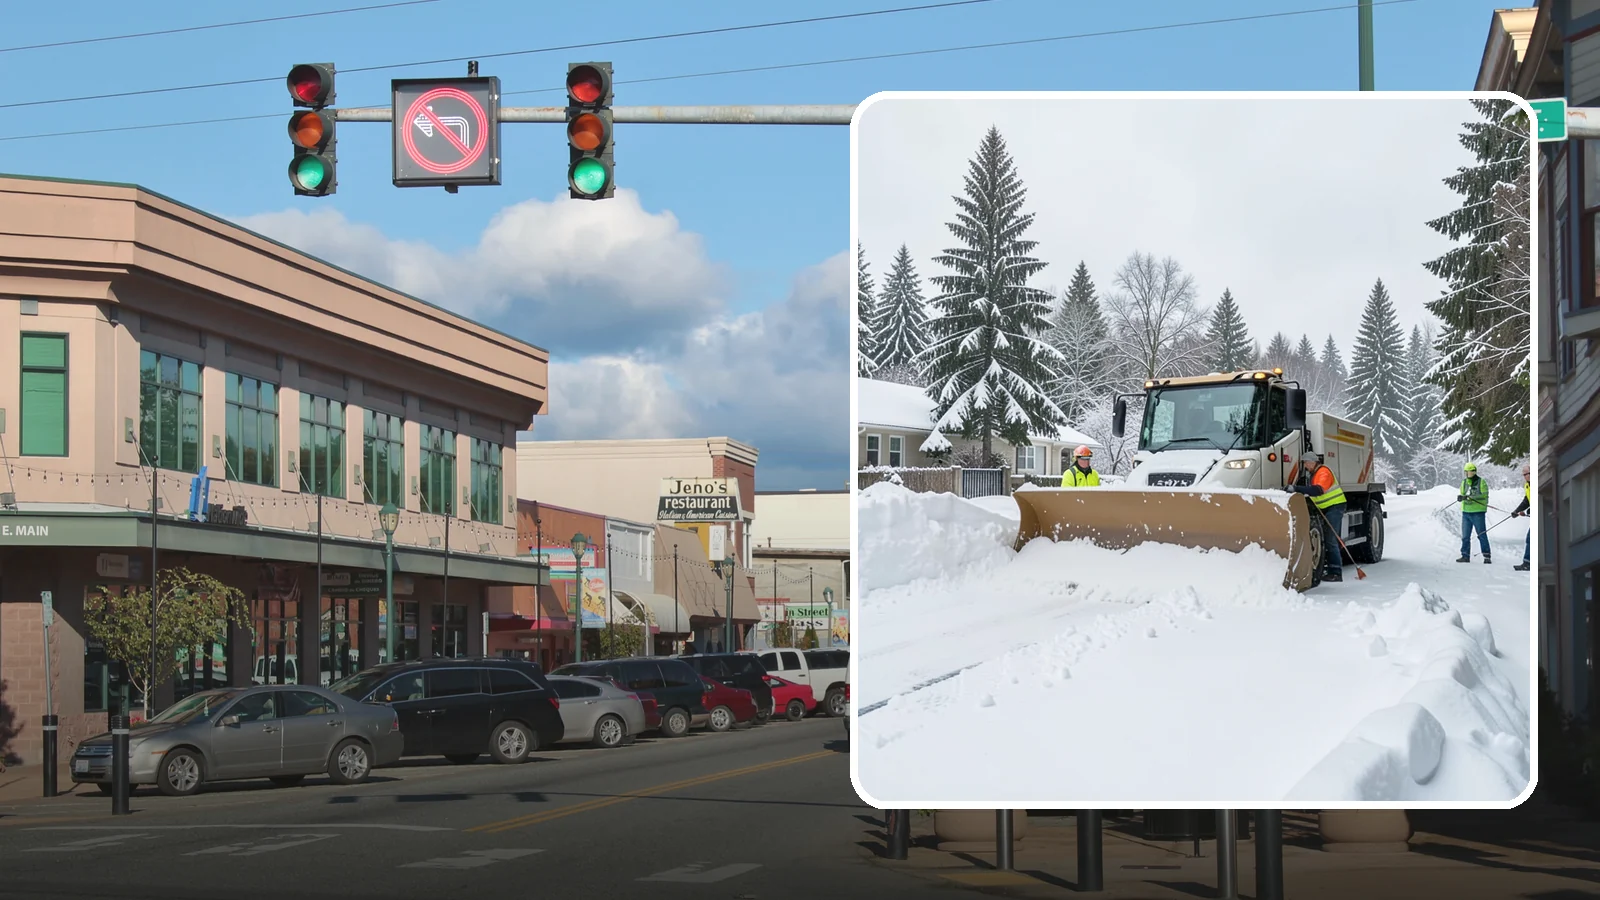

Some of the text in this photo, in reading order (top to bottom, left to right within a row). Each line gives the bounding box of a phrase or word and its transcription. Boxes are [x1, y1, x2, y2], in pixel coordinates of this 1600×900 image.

[670, 480, 728, 494] Jeno's
[665, 496, 731, 509] restaurant
[658, 510, 682, 520] Italian
[686, 510, 714, 519] American
[715, 509, 737, 519] Cuisine
[2, 525, 49, 536] E. MAIN
[797, 607, 829, 617] Street
